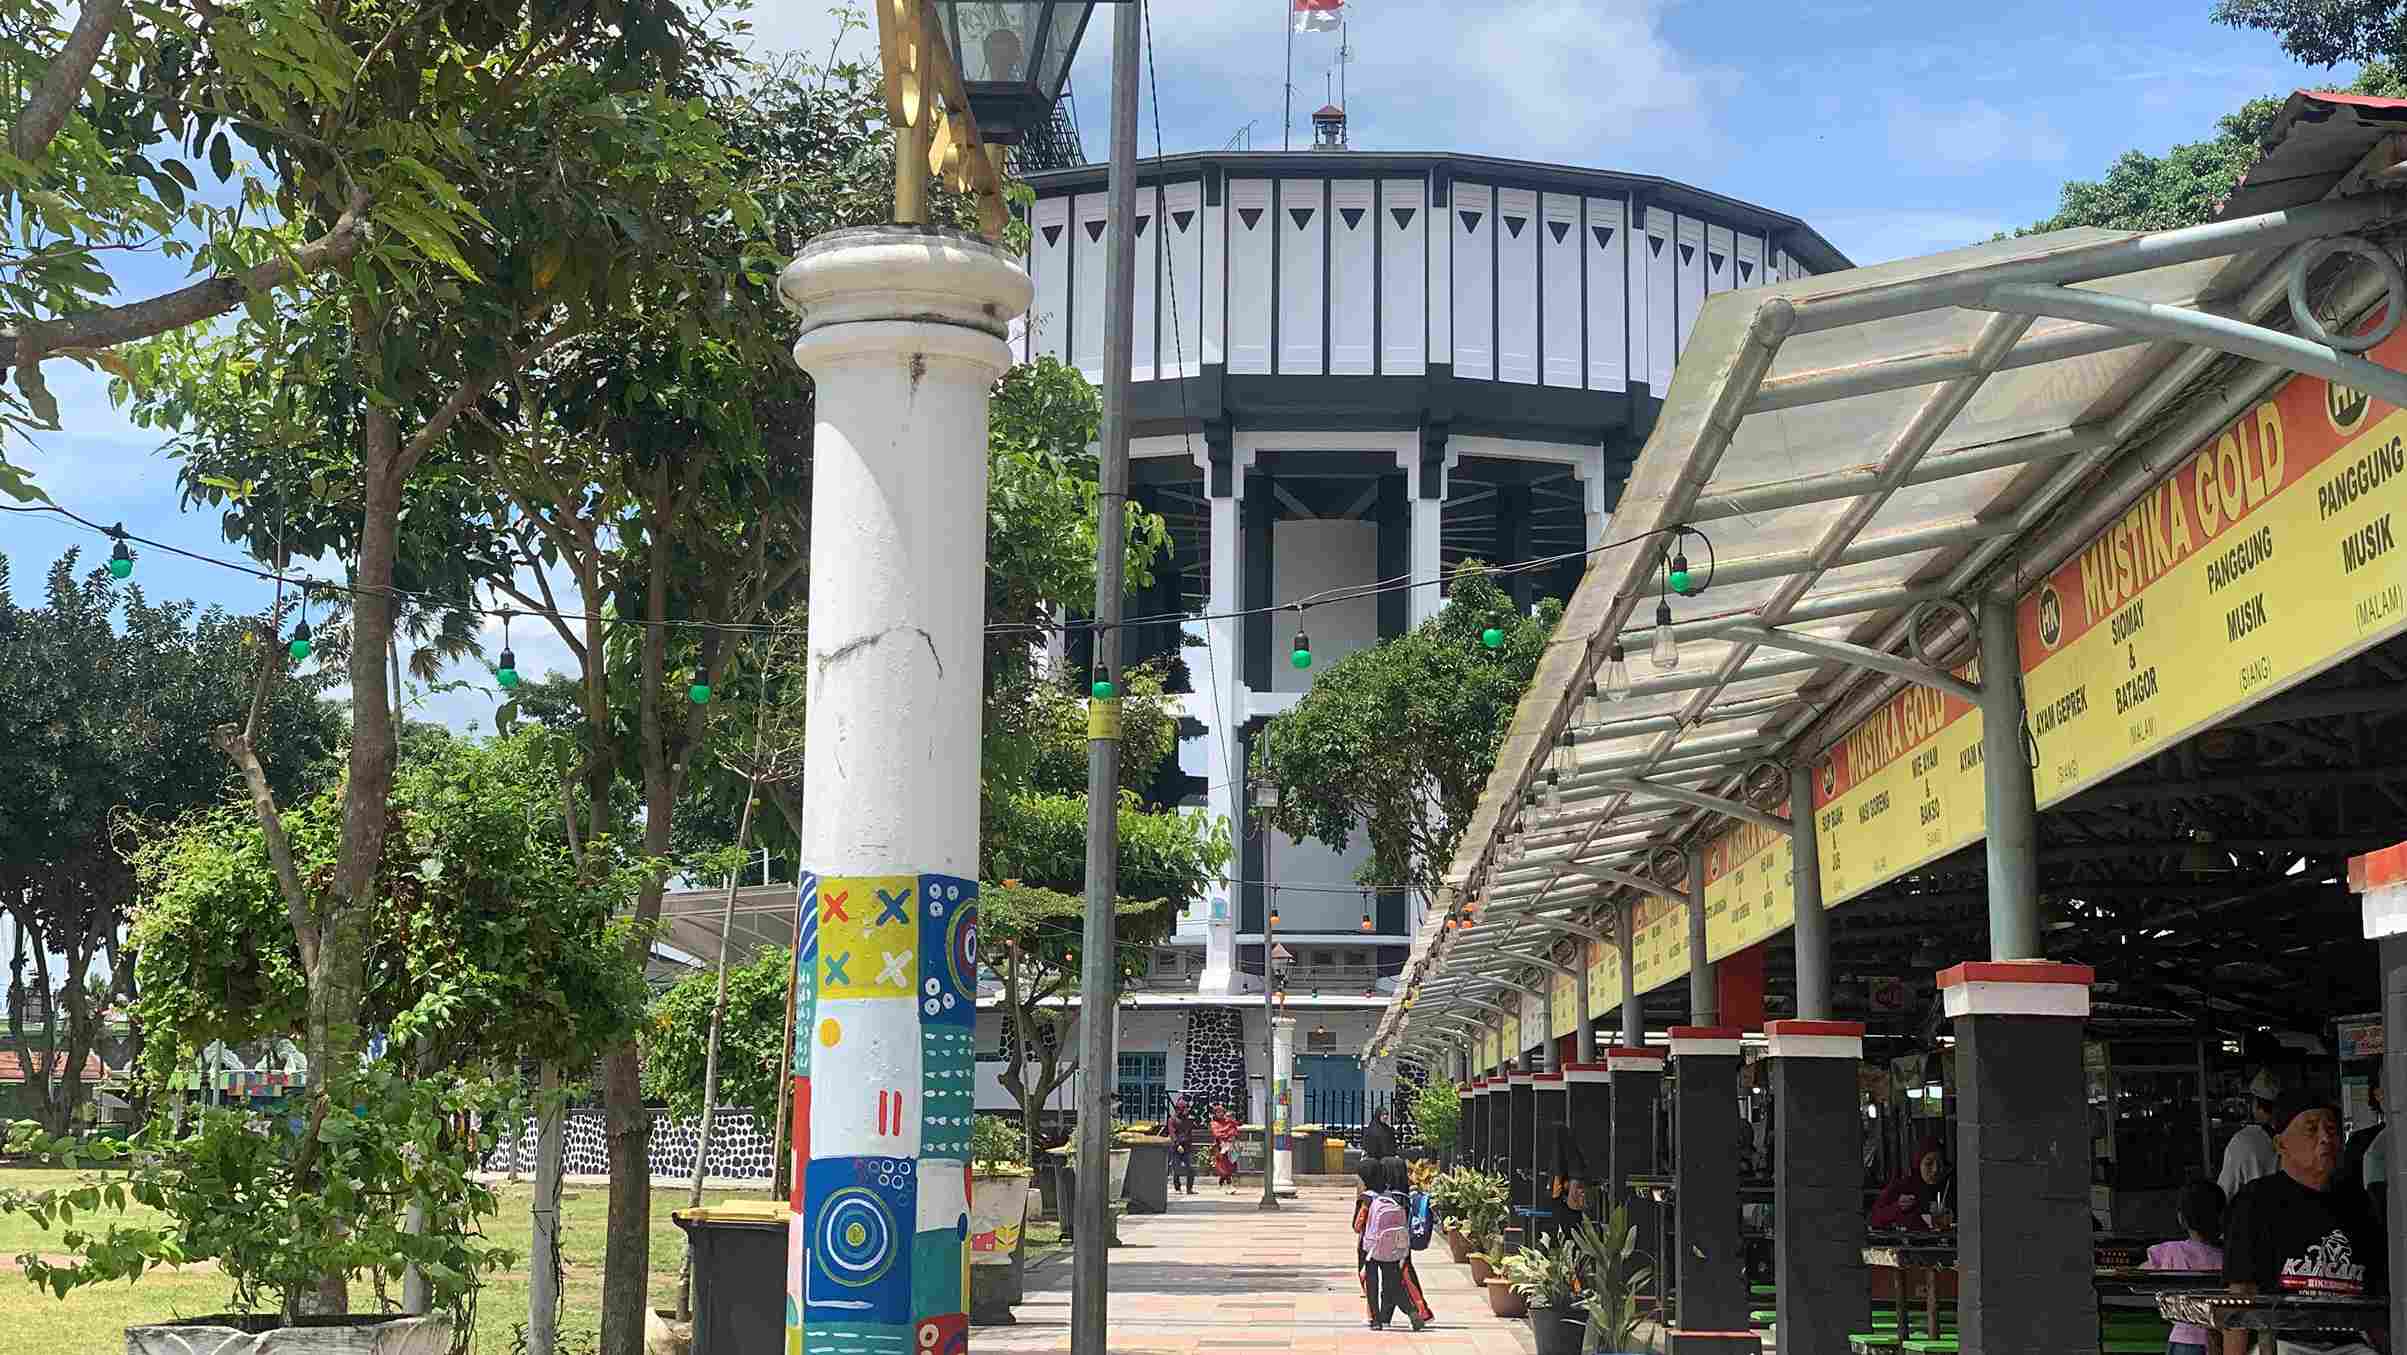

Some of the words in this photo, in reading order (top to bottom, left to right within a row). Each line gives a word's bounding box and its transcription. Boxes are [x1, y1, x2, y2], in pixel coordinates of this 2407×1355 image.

[2318, 436, 2404, 520] PANGGUNG
[2080, 478, 2192, 625] MUSTIKA
[2195, 401, 2285, 538] GOLD
[2207, 526, 2273, 594] PANGGUNG
[2342, 513, 2396, 575] MUSIK
[2111, 599, 2144, 645] SIOMAY
[2226, 593, 2268, 642] MUSIK
[2356, 583, 2404, 634] (MALAM)
[2128, 643, 2137, 670] &
[2240, 655, 2272, 692] (SIANG)
[2035, 704, 2055, 738] AYAM
[2056, 684, 2088, 725] GEPREK
[2115, 667, 2159, 715] BATAGOR
[1847, 705, 1903, 786] MUSTIKA
